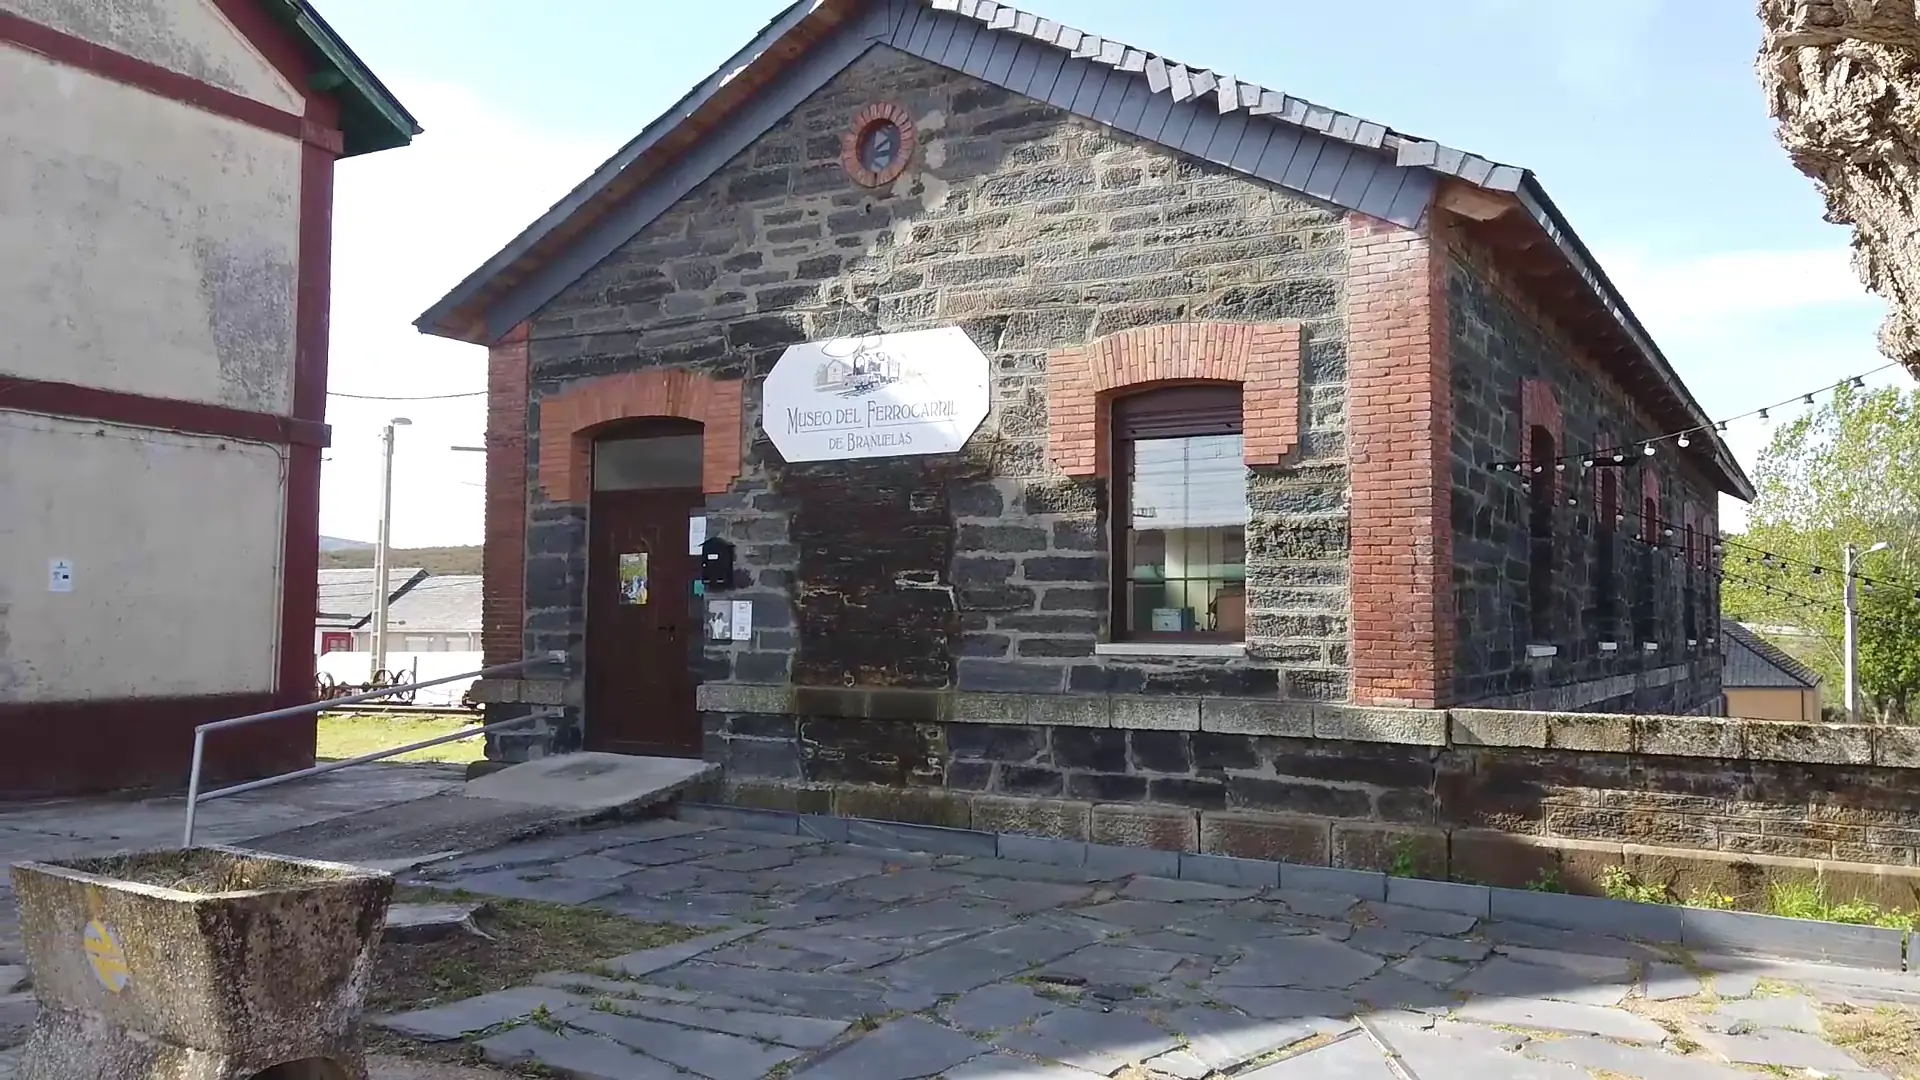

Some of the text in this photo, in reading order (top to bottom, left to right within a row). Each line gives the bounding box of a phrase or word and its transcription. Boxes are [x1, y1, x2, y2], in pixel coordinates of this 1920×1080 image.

[787, 400, 958, 434] MUSEO DEL FERROCARRIL
[829, 437, 844, 450] DE
